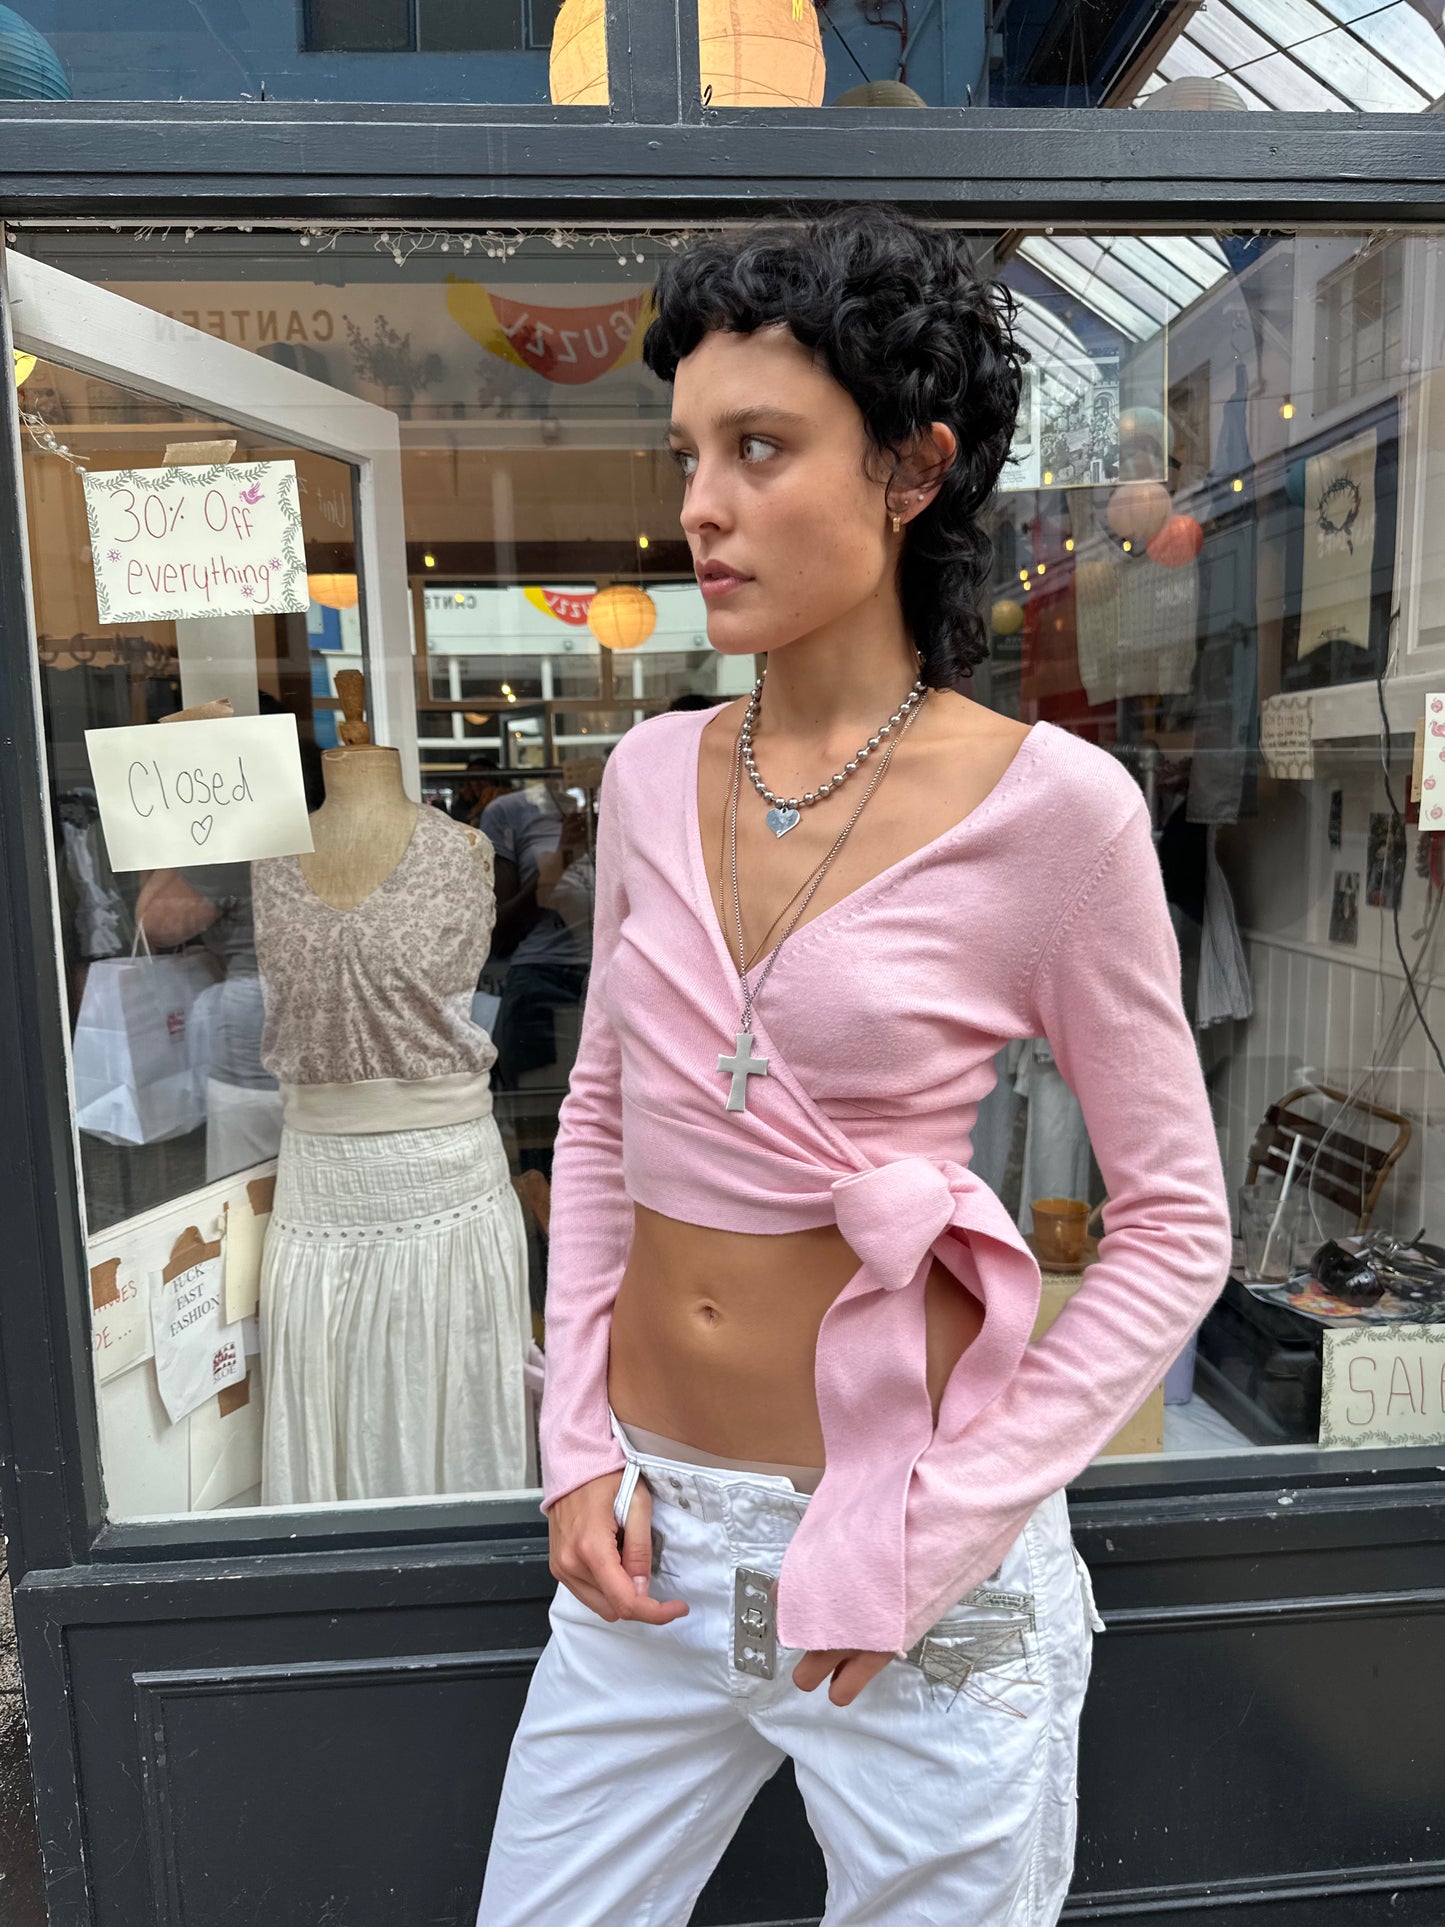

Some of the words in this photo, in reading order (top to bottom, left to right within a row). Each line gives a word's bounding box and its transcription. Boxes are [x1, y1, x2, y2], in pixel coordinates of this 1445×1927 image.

[109, 488, 185, 543] 30%
[204, 489, 254, 540] Off
[127, 555, 270, 605] everything
[128, 756, 254, 818] Closed
[172, 1264, 205, 1293] FUCK
[176, 1283, 204, 1311] FAST
[169, 1294, 220, 1337] FASHION
